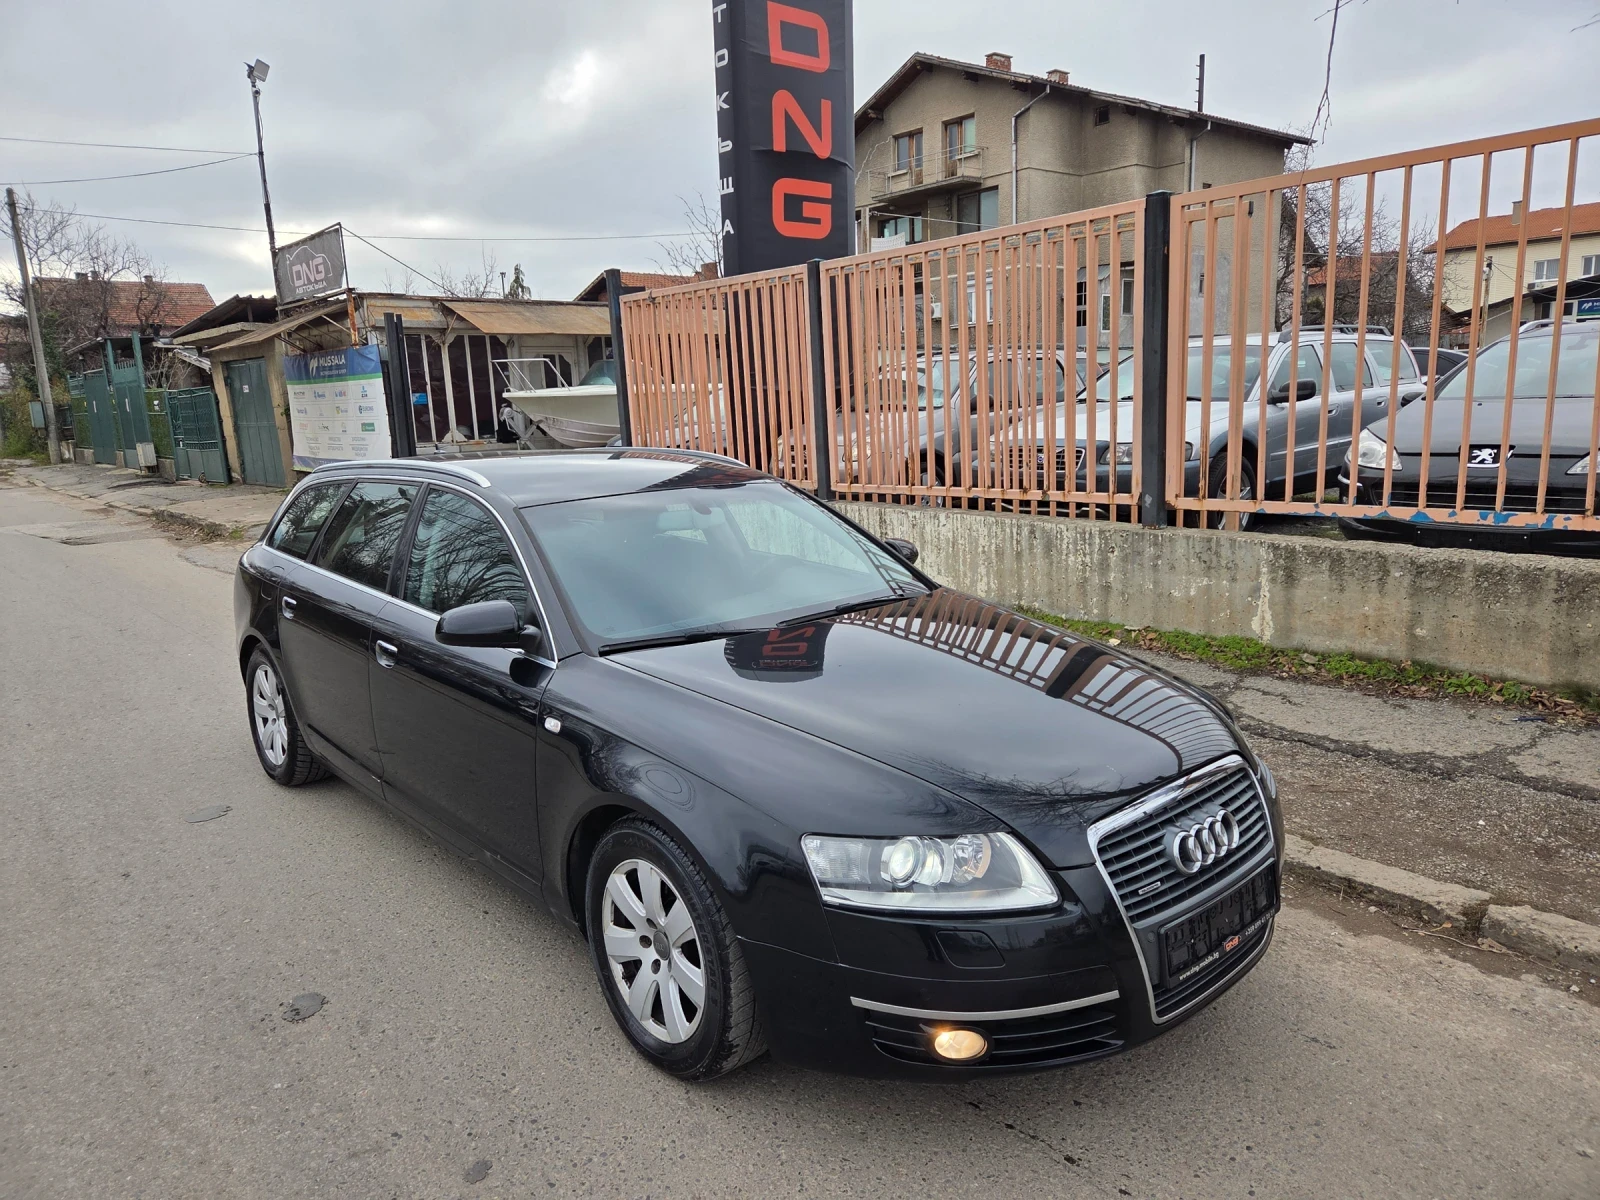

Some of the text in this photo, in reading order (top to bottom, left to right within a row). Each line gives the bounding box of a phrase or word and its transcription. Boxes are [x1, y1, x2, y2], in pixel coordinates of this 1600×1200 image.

[767, 1, 832, 240] DNG
[292, 257, 325, 287] DNG
[319, 354, 346, 367] MUSSALA
